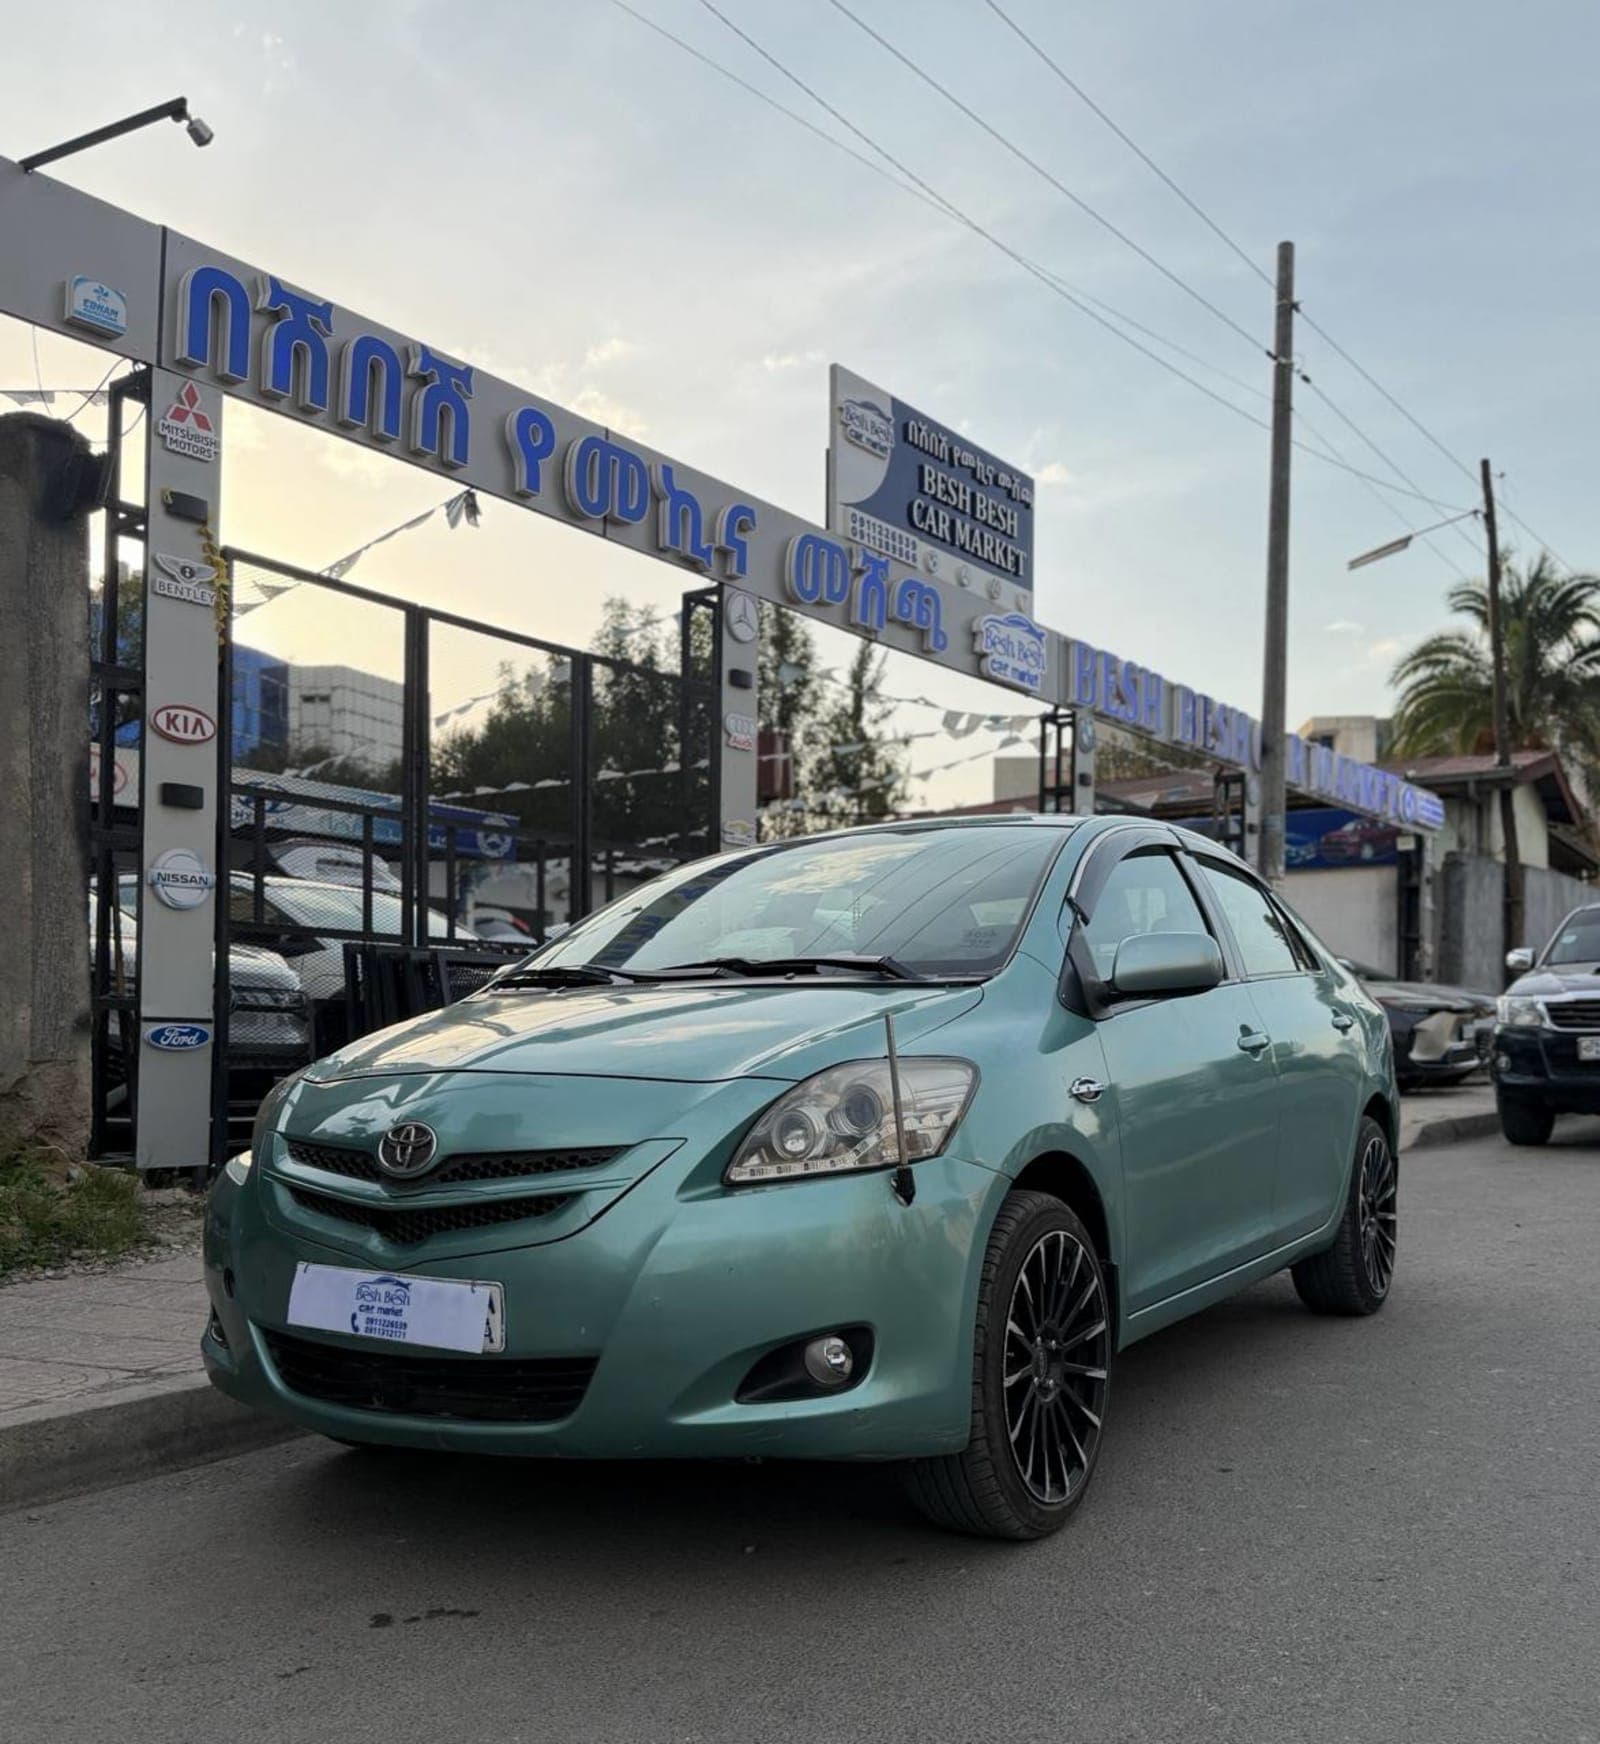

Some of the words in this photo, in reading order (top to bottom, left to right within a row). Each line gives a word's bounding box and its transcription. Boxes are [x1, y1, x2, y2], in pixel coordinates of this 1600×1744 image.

[161, 422, 216, 447] MITSUBISH
[169, 437, 212, 459] MOTORS
[505, 405, 757, 578] የመኪና
[922, 463, 971, 514] BESH
[975, 492, 1018, 538] BESH
[912, 498, 953, 542] CAR
[956, 519, 1028, 576] MARKET
[157, 579, 215, 605] BENTLEY
[985, 625, 1015, 659] Besh
[1073, 639, 1164, 734] BESH
[1178, 684, 1250, 767] BESH
[165, 711, 206, 738] KIA
[156, 871, 209, 886] NISSAN
[160, 1026, 202, 1046] Ford
[355, 1285, 382, 1302] Besh
[384, 1289, 410, 1306] Besh
[359, 1304, 375, 1313] car
[377, 1306, 404, 1317] market
